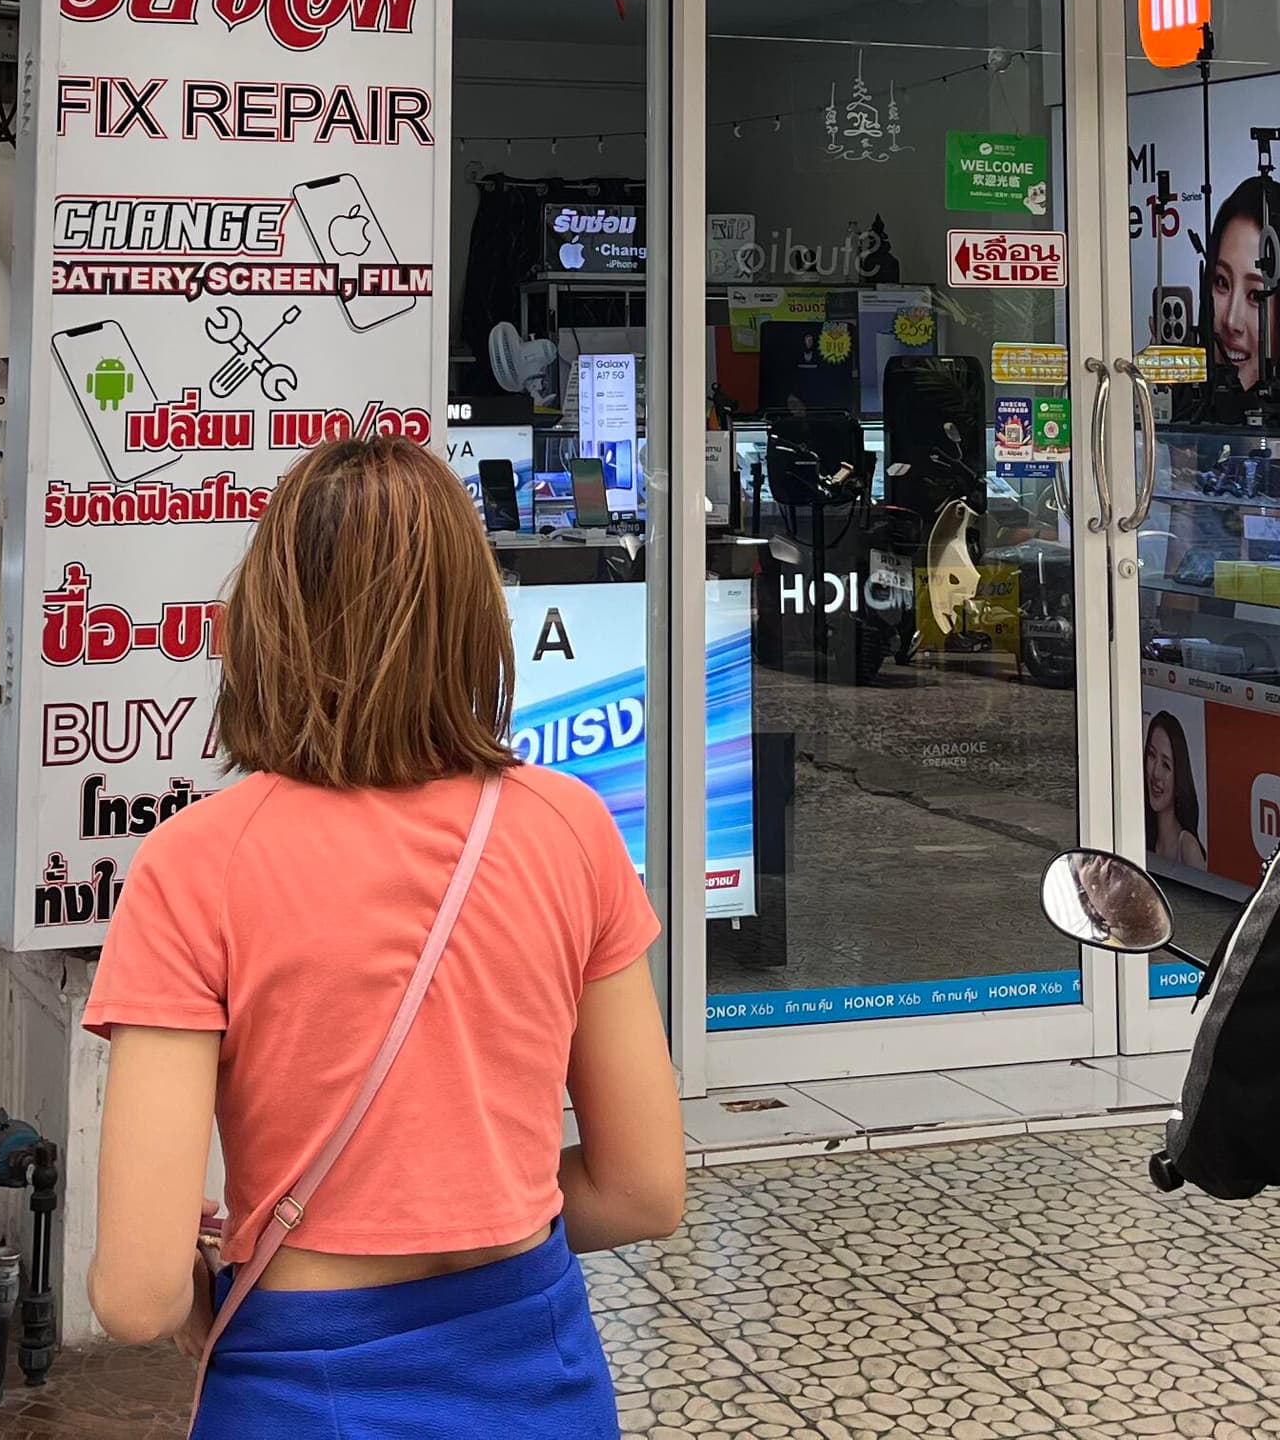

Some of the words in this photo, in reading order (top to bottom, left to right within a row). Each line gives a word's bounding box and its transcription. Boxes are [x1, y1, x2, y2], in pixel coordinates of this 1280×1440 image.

[57, 75, 168, 139] FIX
[182, 79, 435, 146] REPAIR
[960, 158, 1034, 176] WELCOME
[971, 174, 1021, 189] 欢迎光临
[53, 197, 292, 254] CHANGE
[552, 208, 637, 234] รับซ่อม
[971, 234, 1061, 263] เลื่อน
[358, 266, 433, 295] FILM
[972, 263, 1060, 282] SLIDE
[596, 360, 630, 371] Galaxy
[125, 387, 253, 452] เปลี่ยน
[531, 607, 575, 661] A
[42, 697, 196, 768] BUY
[922, 741, 988, 757] KARAOKE
[750, 1000, 775, 1016] X6b
[844, 995, 895, 1010] HONOR
[898, 991, 922, 1006] X6b
